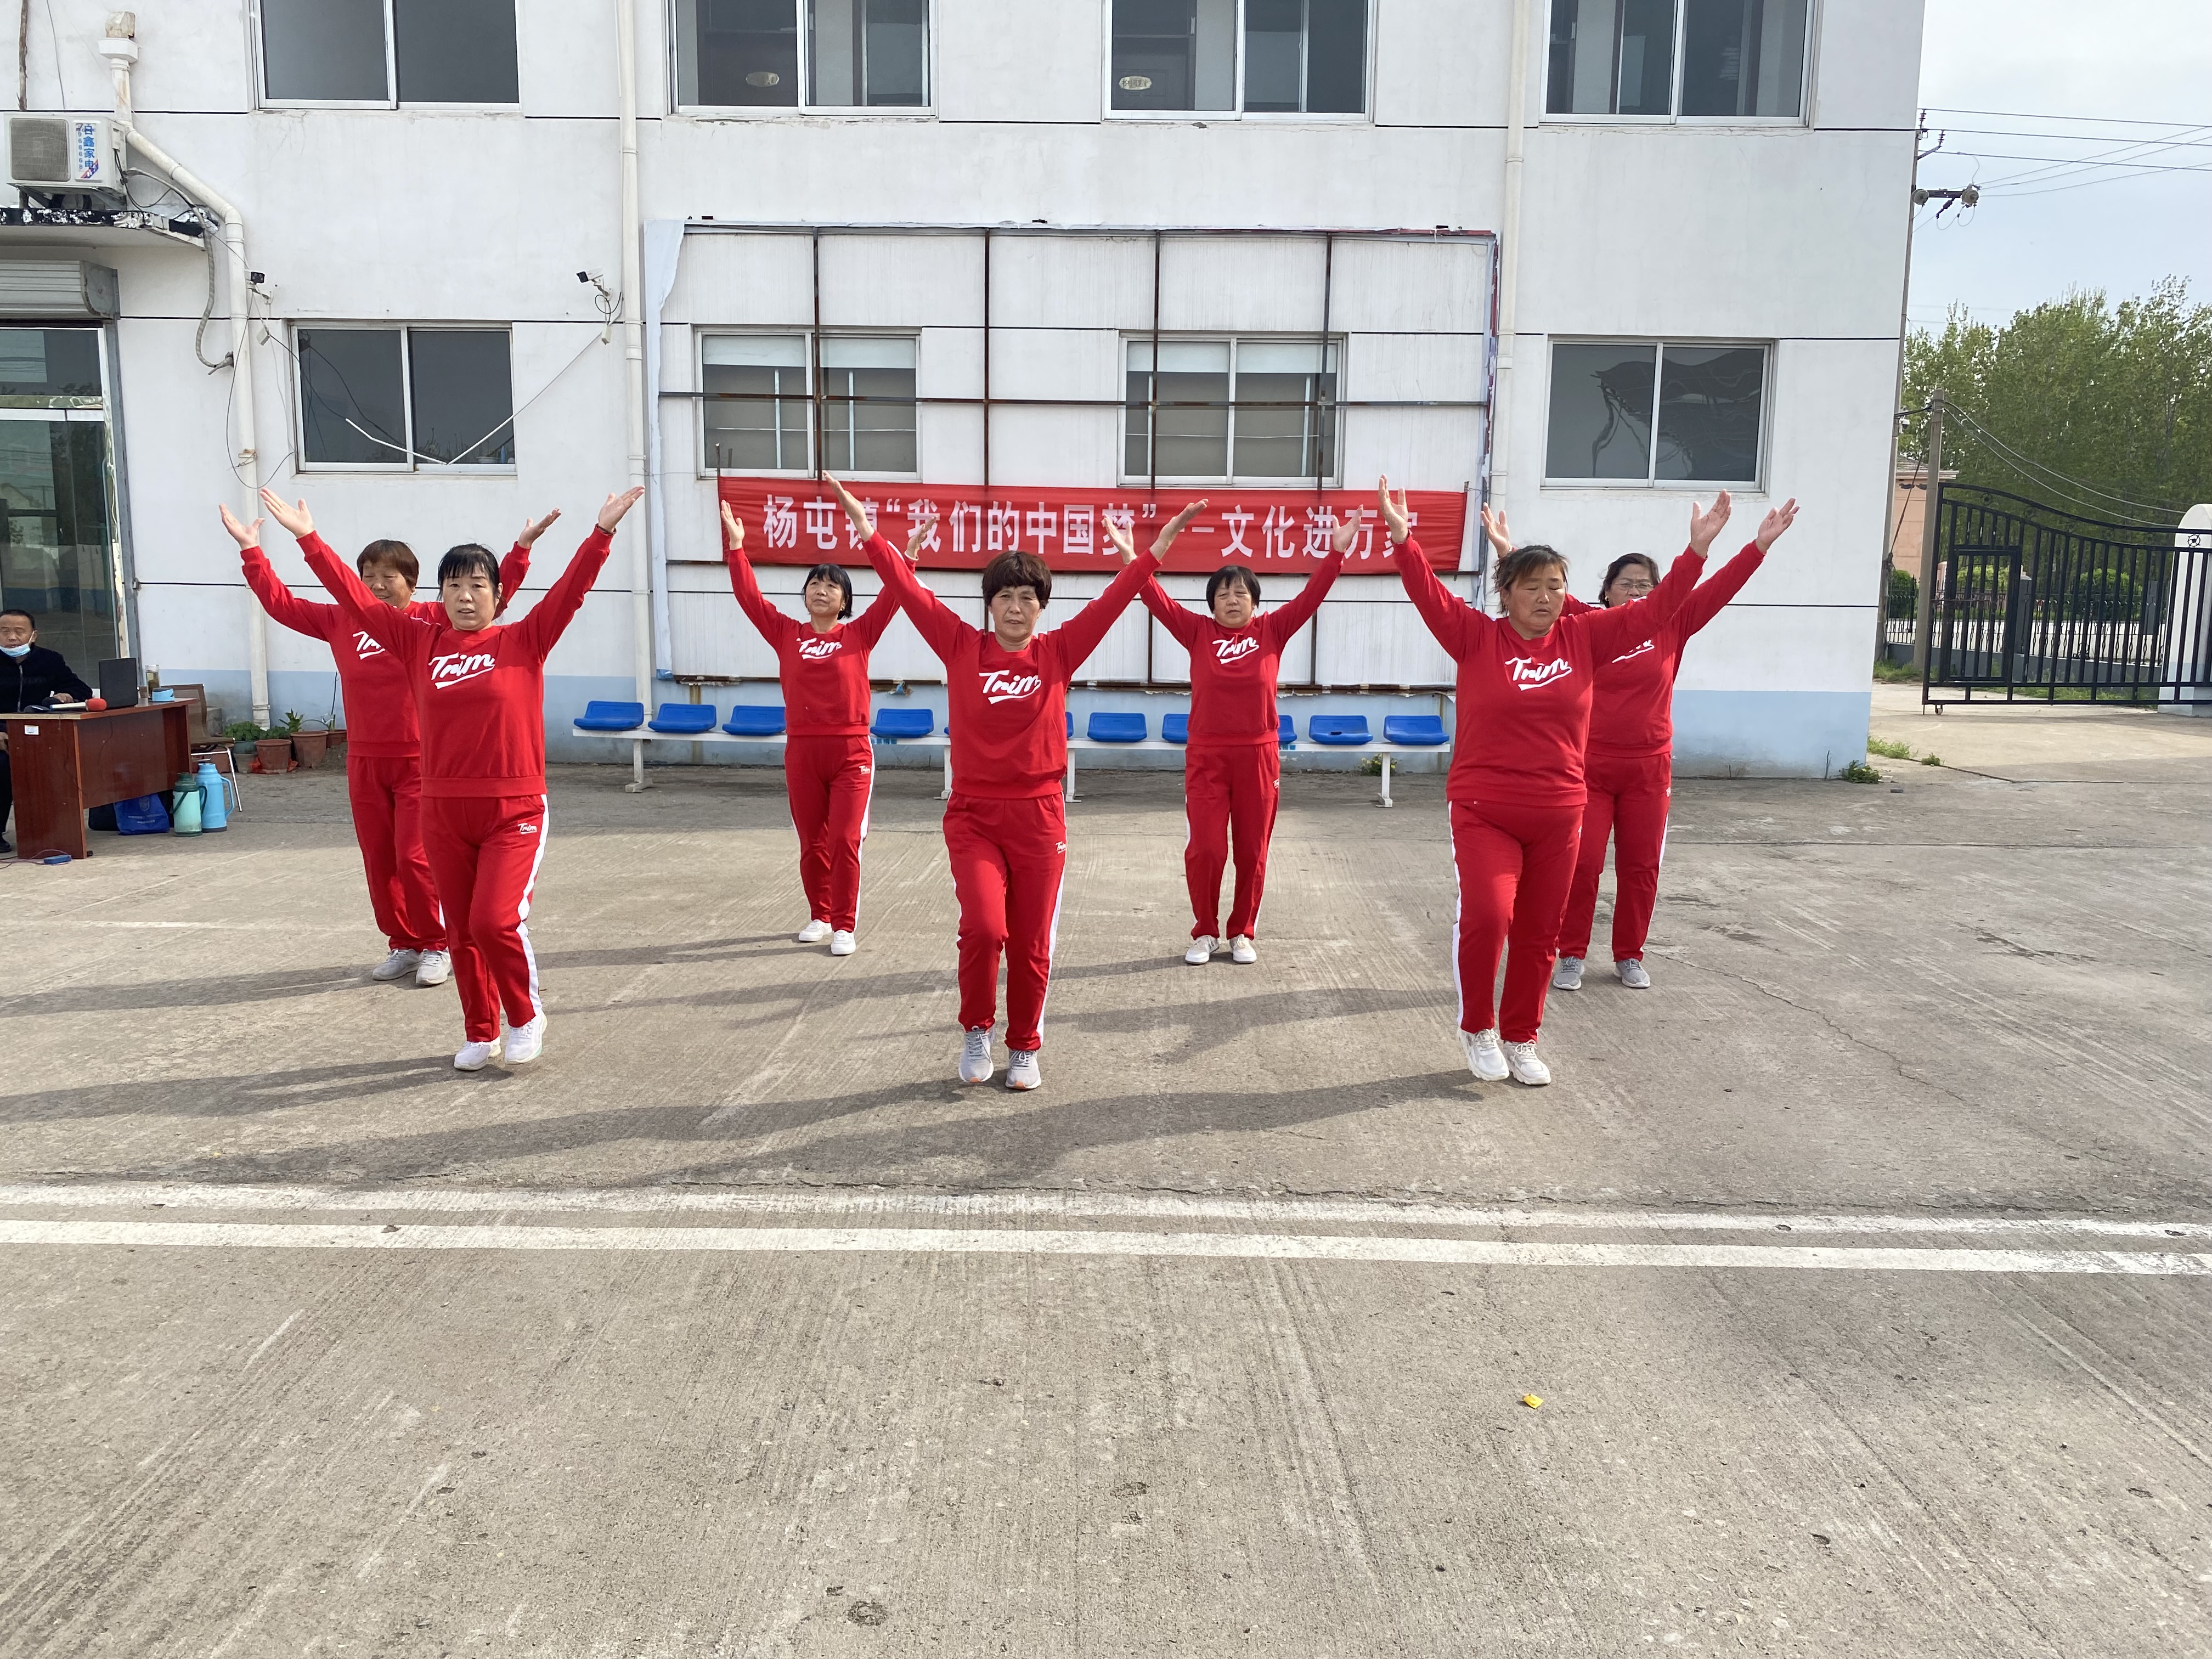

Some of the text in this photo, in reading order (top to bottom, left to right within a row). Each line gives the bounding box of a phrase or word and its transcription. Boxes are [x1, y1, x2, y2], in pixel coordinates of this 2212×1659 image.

[763, 494, 1418, 560] 杨屯镇“我们的中国梦”—文化进万
[796, 637, 842, 659] Trim
[428, 652, 495, 689] Trim
[978, 669, 1042, 704] Trim
